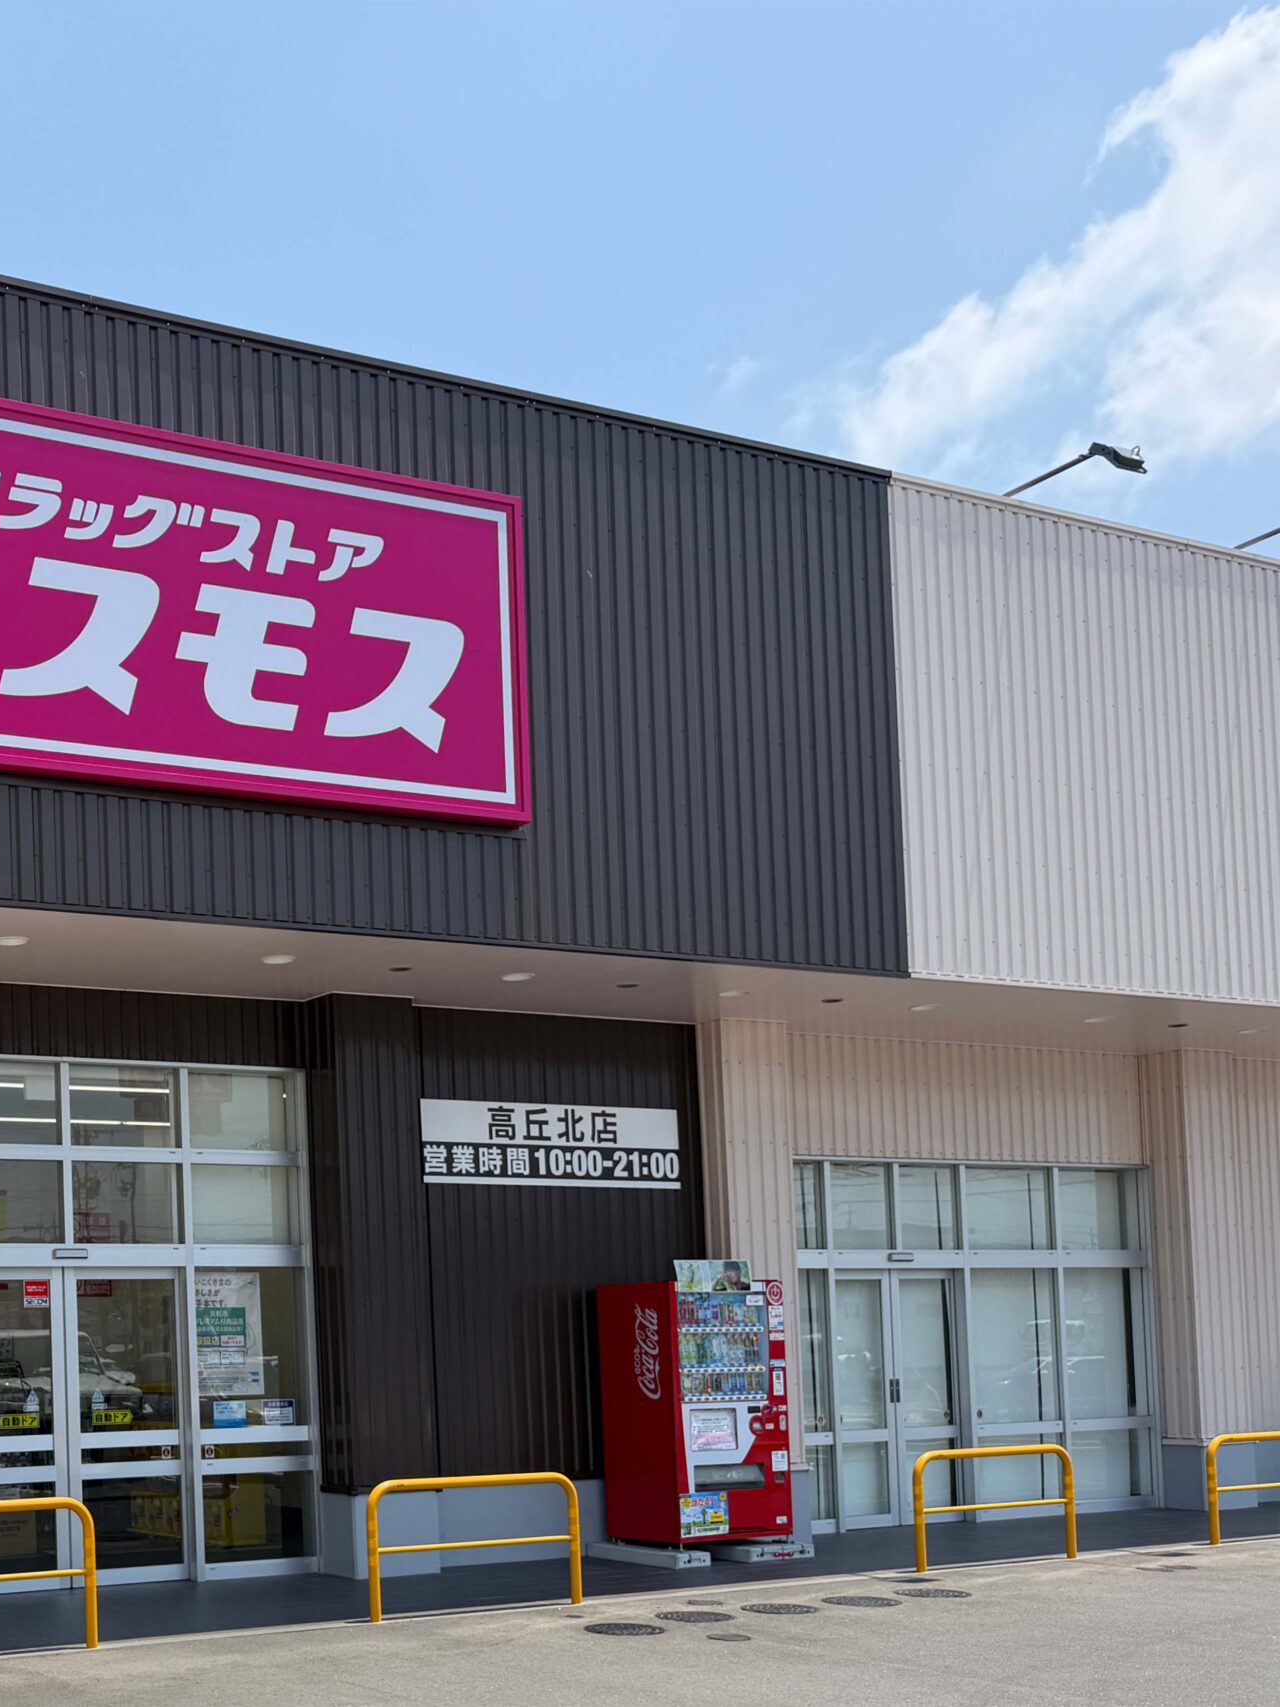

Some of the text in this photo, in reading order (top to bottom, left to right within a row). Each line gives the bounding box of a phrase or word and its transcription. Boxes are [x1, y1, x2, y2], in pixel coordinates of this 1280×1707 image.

[487, 1106, 617, 1144] 高丘北店
[636, 1304, 659, 1399] Coca-Cola
[2, 1416, 37, 1426] 自動ドア
[95, 1412, 128, 1422] 自動ドア
